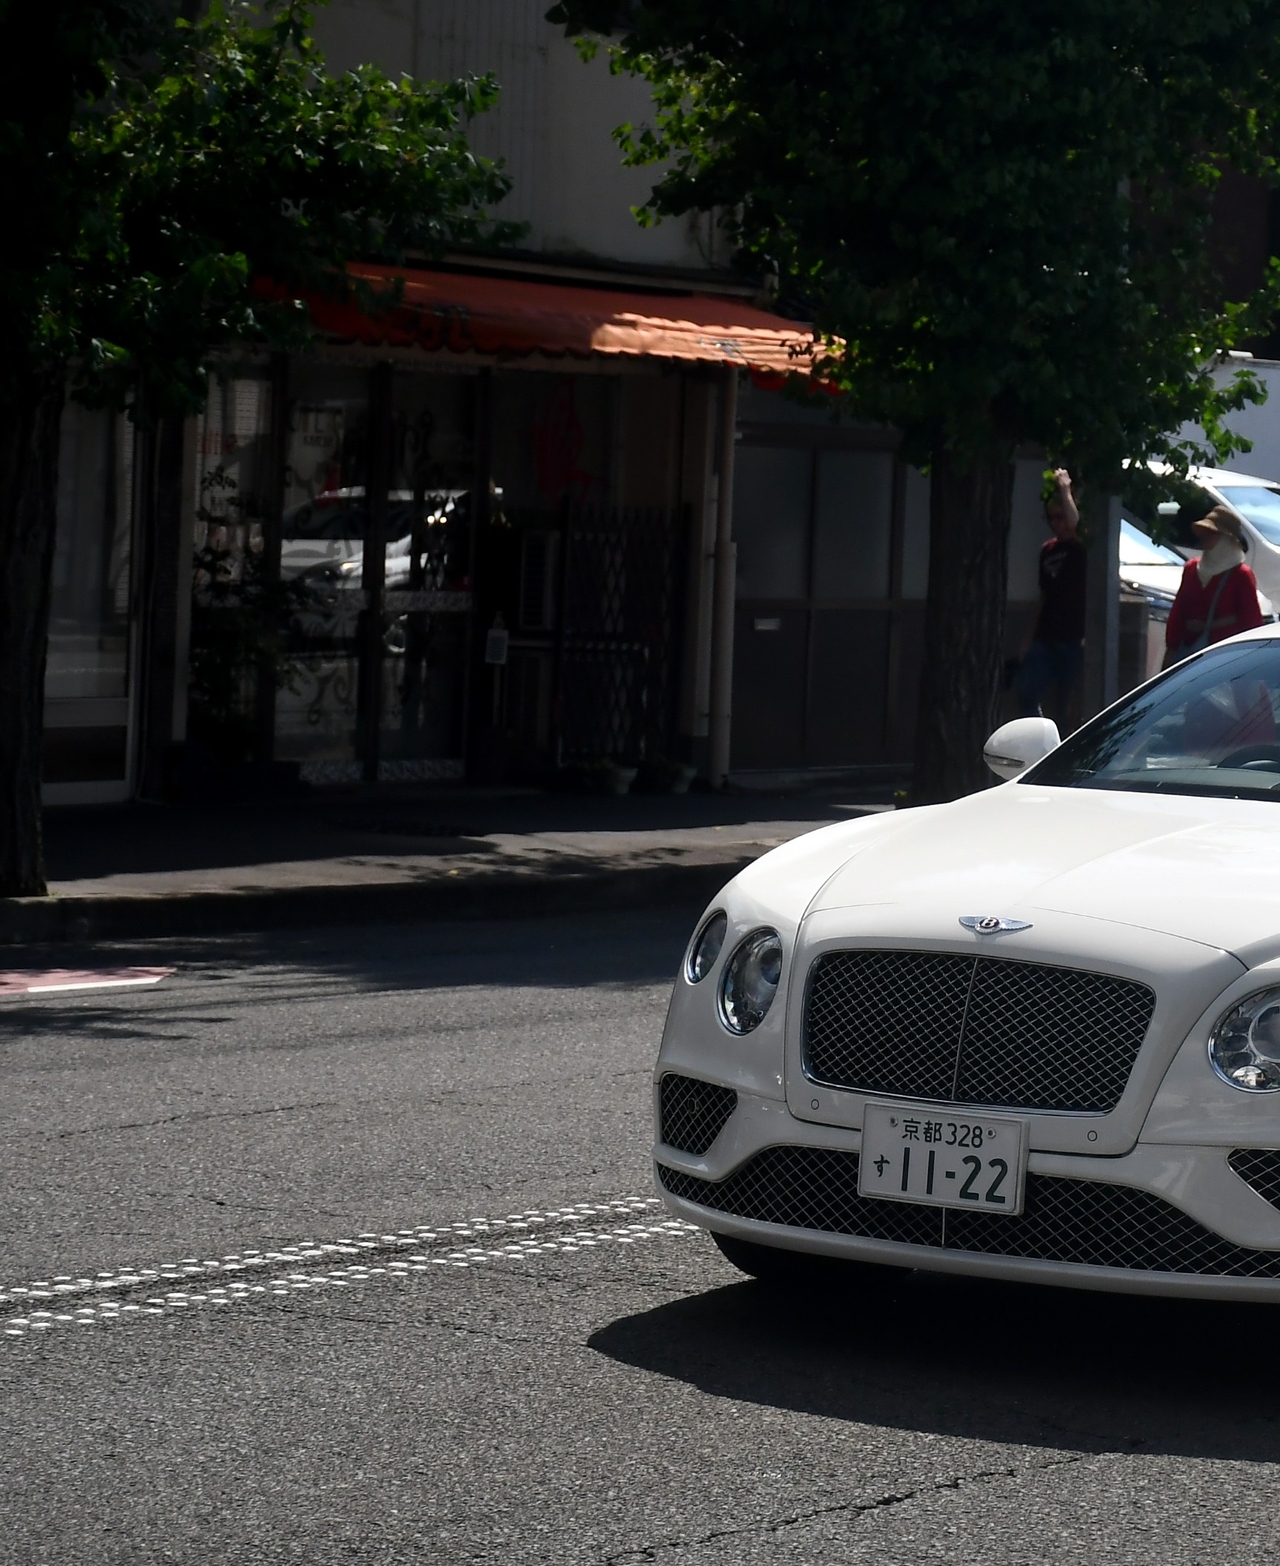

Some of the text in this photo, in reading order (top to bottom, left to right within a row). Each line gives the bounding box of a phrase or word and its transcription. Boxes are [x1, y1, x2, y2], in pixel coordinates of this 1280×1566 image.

[902, 1118, 984, 1149] 京都328
[873, 1146, 1009, 1204] す 11-22
